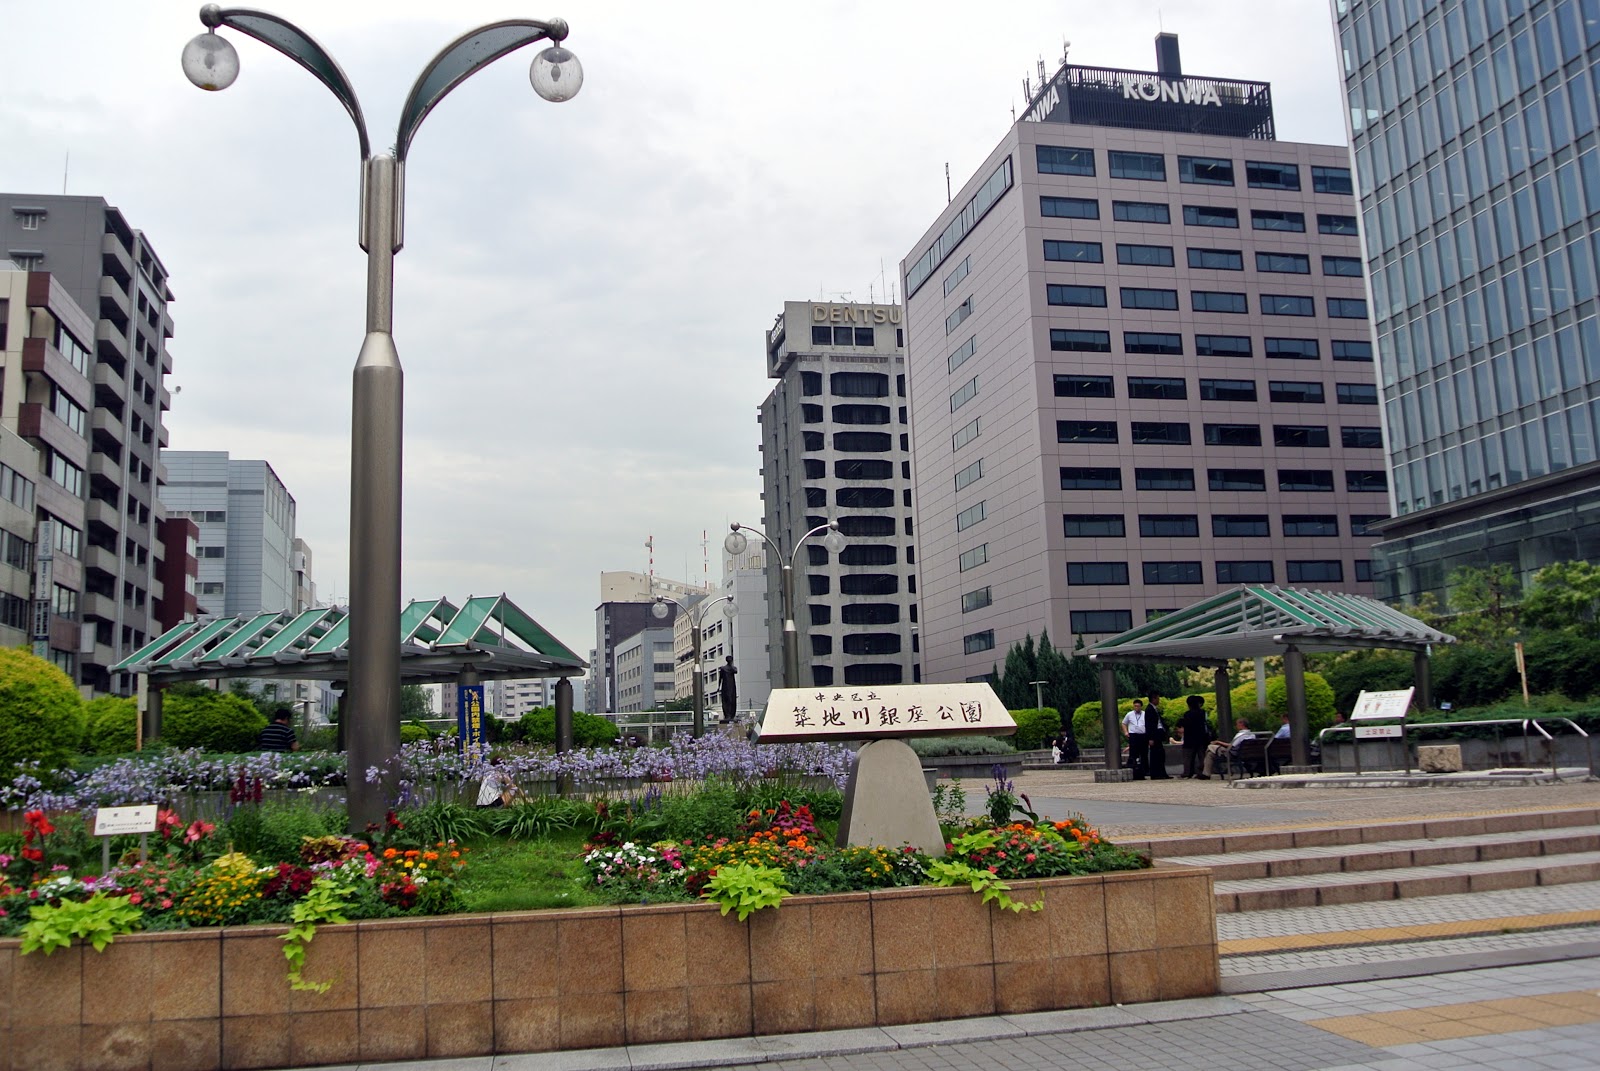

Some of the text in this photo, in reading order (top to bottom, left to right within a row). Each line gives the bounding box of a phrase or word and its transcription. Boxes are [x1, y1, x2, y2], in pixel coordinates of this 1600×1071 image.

[1123, 76, 1222, 107] KONWA
[813, 305, 902, 324] DENTSU
[815, 692, 881, 702] 中央区立
[793, 700, 982, 727] 築地川銀座公園
